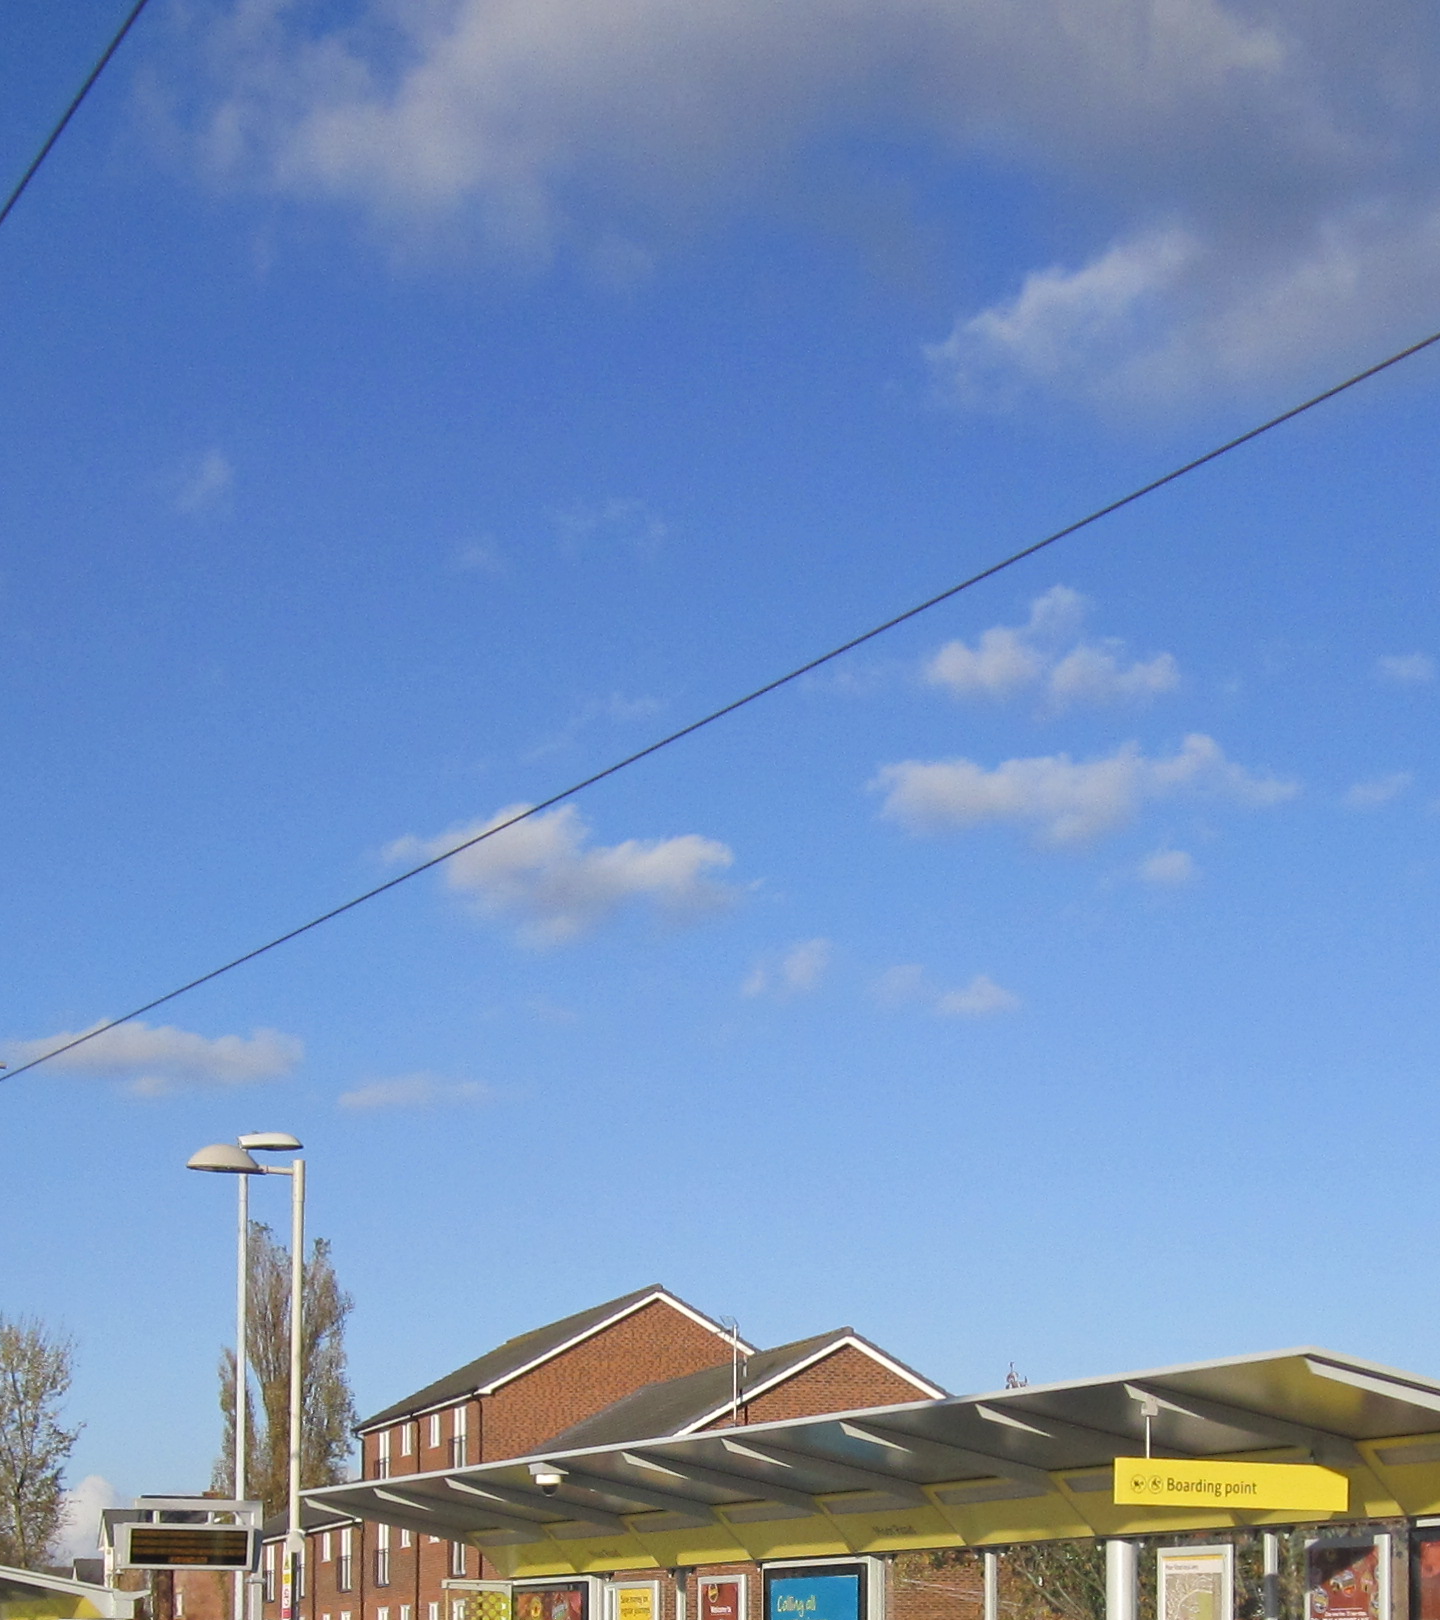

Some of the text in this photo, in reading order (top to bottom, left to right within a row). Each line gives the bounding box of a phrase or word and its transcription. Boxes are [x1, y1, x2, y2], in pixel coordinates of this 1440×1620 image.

[1167, 1478, 1257, 1497] Boarding point
[777, 1595, 804, 1617] Calling
